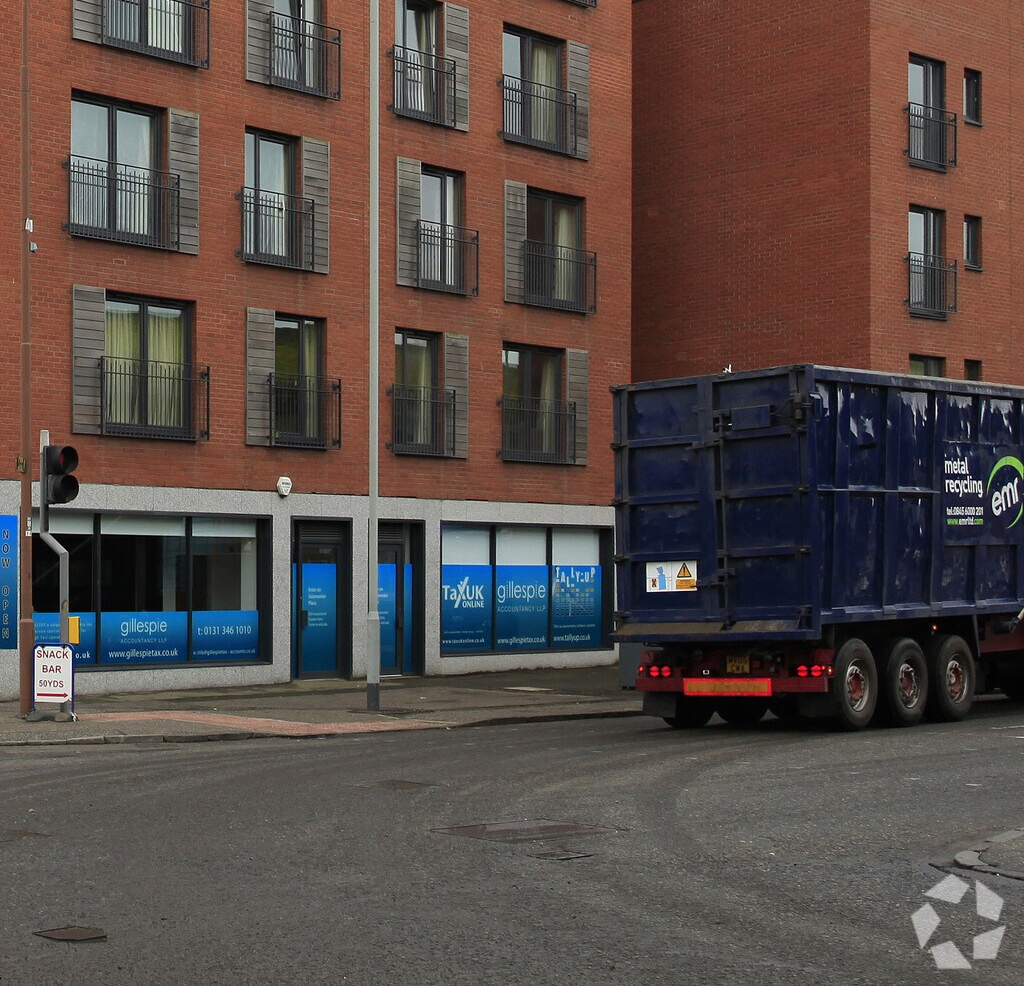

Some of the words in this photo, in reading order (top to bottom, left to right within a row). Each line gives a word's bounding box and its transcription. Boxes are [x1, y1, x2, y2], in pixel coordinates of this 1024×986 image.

[944, 457, 969, 474] metal
[945, 476, 983, 498] recycling
[992, 477, 1019, 516] emr
[2, 529, 10, 568] NOW
[497, 580, 546, 603] gillespie
[2, 585, 10, 639] OPEN
[120, 618, 168, 636] gillespie
[222, 626, 234, 635] 346
[236, 625, 251, 634] 1010
[497, 636, 545, 645] www.gillespietax.co.uk
[36, 650, 69, 659] SNACK
[108, 648, 178, 659] www.gillespietax.co.uk
[42, 665, 62, 674] BAR
[39, 680, 64, 688] 50YDS
